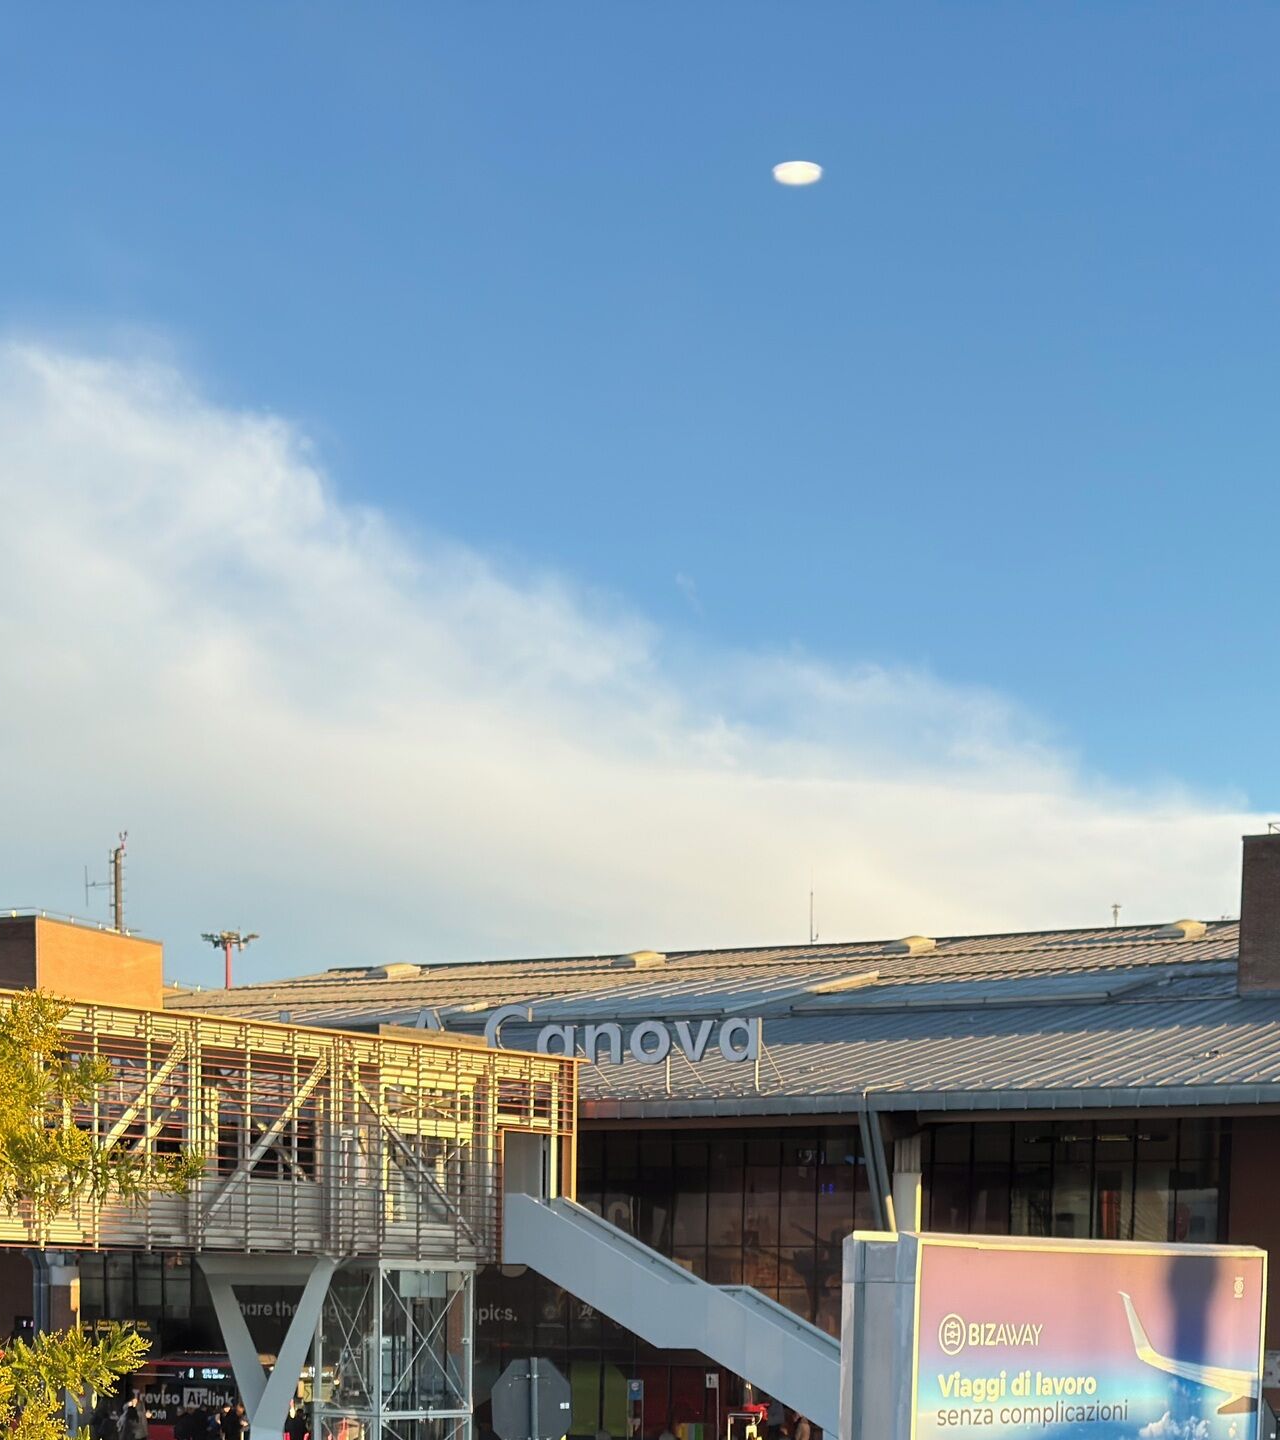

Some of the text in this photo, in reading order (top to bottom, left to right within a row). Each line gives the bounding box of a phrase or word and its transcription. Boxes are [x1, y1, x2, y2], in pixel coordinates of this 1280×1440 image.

[484, 1005, 762, 1065] Canova
[968, 1323, 1043, 1347] BIZAWAY
[937, 1370, 1097, 1403] Viaggi di lavoro
[937, 1399, 1129, 1427] senza complicazioni
